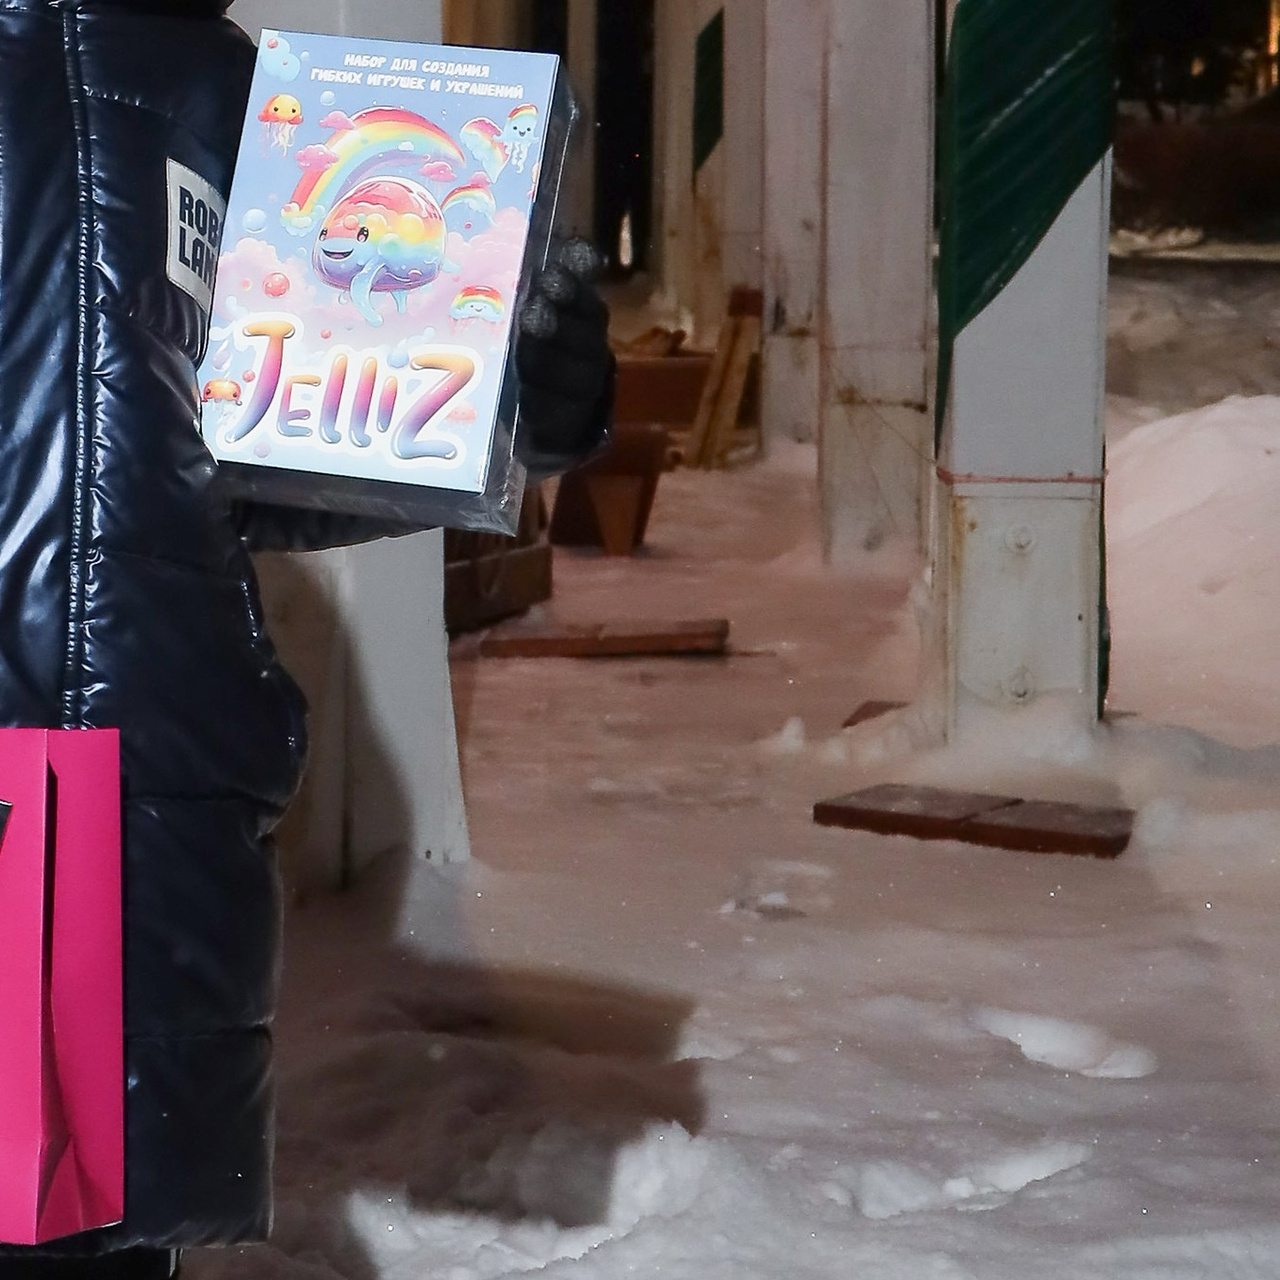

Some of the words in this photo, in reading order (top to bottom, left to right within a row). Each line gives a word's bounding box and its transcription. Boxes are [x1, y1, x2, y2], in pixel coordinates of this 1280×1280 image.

[343, 53, 387, 68] НАБОР
[390, 57, 417, 72] ДЛЯ
[421, 60, 490, 78] СОЗДАНИЯ
[310, 68, 362, 85] ГИБКИХ
[366, 73, 426, 91] ИГРУШЕК
[429, 79, 442, 92] И
[444, 79, 524, 99] УКРАШЕНИЙ
[179, 185, 223, 248] ROB
